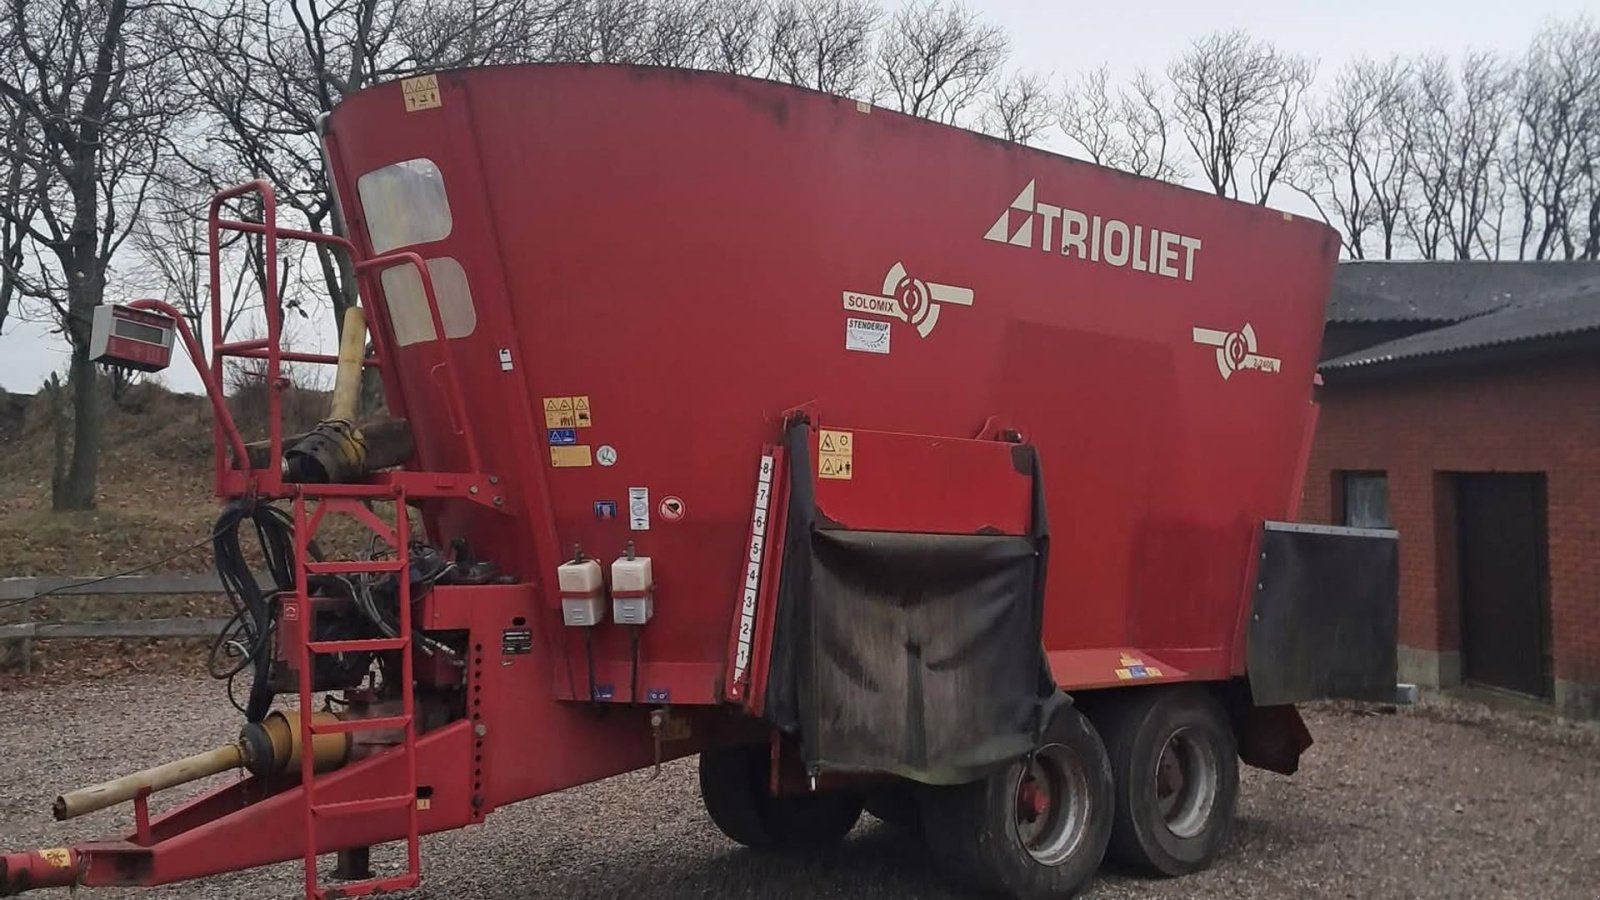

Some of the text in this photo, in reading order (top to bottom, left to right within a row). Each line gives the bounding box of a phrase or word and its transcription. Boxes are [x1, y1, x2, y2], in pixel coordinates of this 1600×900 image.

[1036, 202, 1202, 281] TRIOLIET
[848, 295, 895, 313] SOLOMIX
[848, 319, 889, 331] STENDERUP
[762, 462, 770, 474] 8
[760, 488, 766, 500] 7
[756, 516, 762, 528] 6
[752, 542, 760, 554] 5
[748, 570, 756, 580] 4
[746, 596, 752, 608] 3
[742, 622, 750, 636] 2
